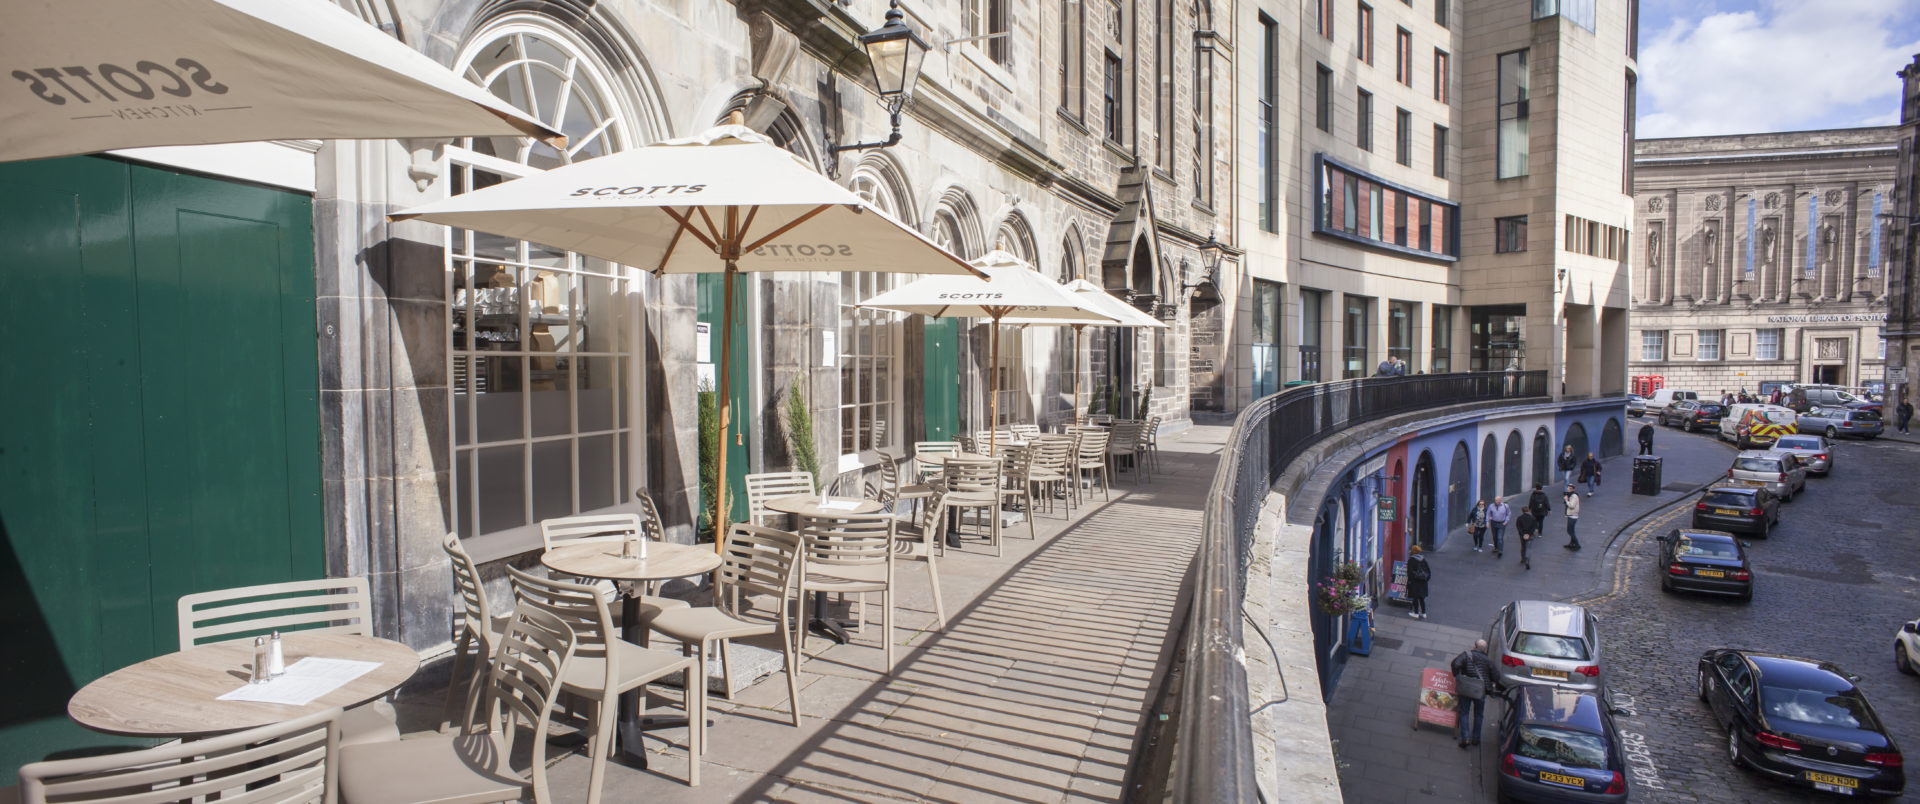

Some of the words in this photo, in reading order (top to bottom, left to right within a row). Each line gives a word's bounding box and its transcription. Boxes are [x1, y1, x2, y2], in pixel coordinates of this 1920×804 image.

[569, 184, 707, 197] SCOTTS
[1768, 315, 1807, 323] NATIONAL
[1855, 313, 1888, 322] SCOTLA
[1619, 729, 1665, 790] HOLDERS
[1814, 772, 1835, 783] SE12
